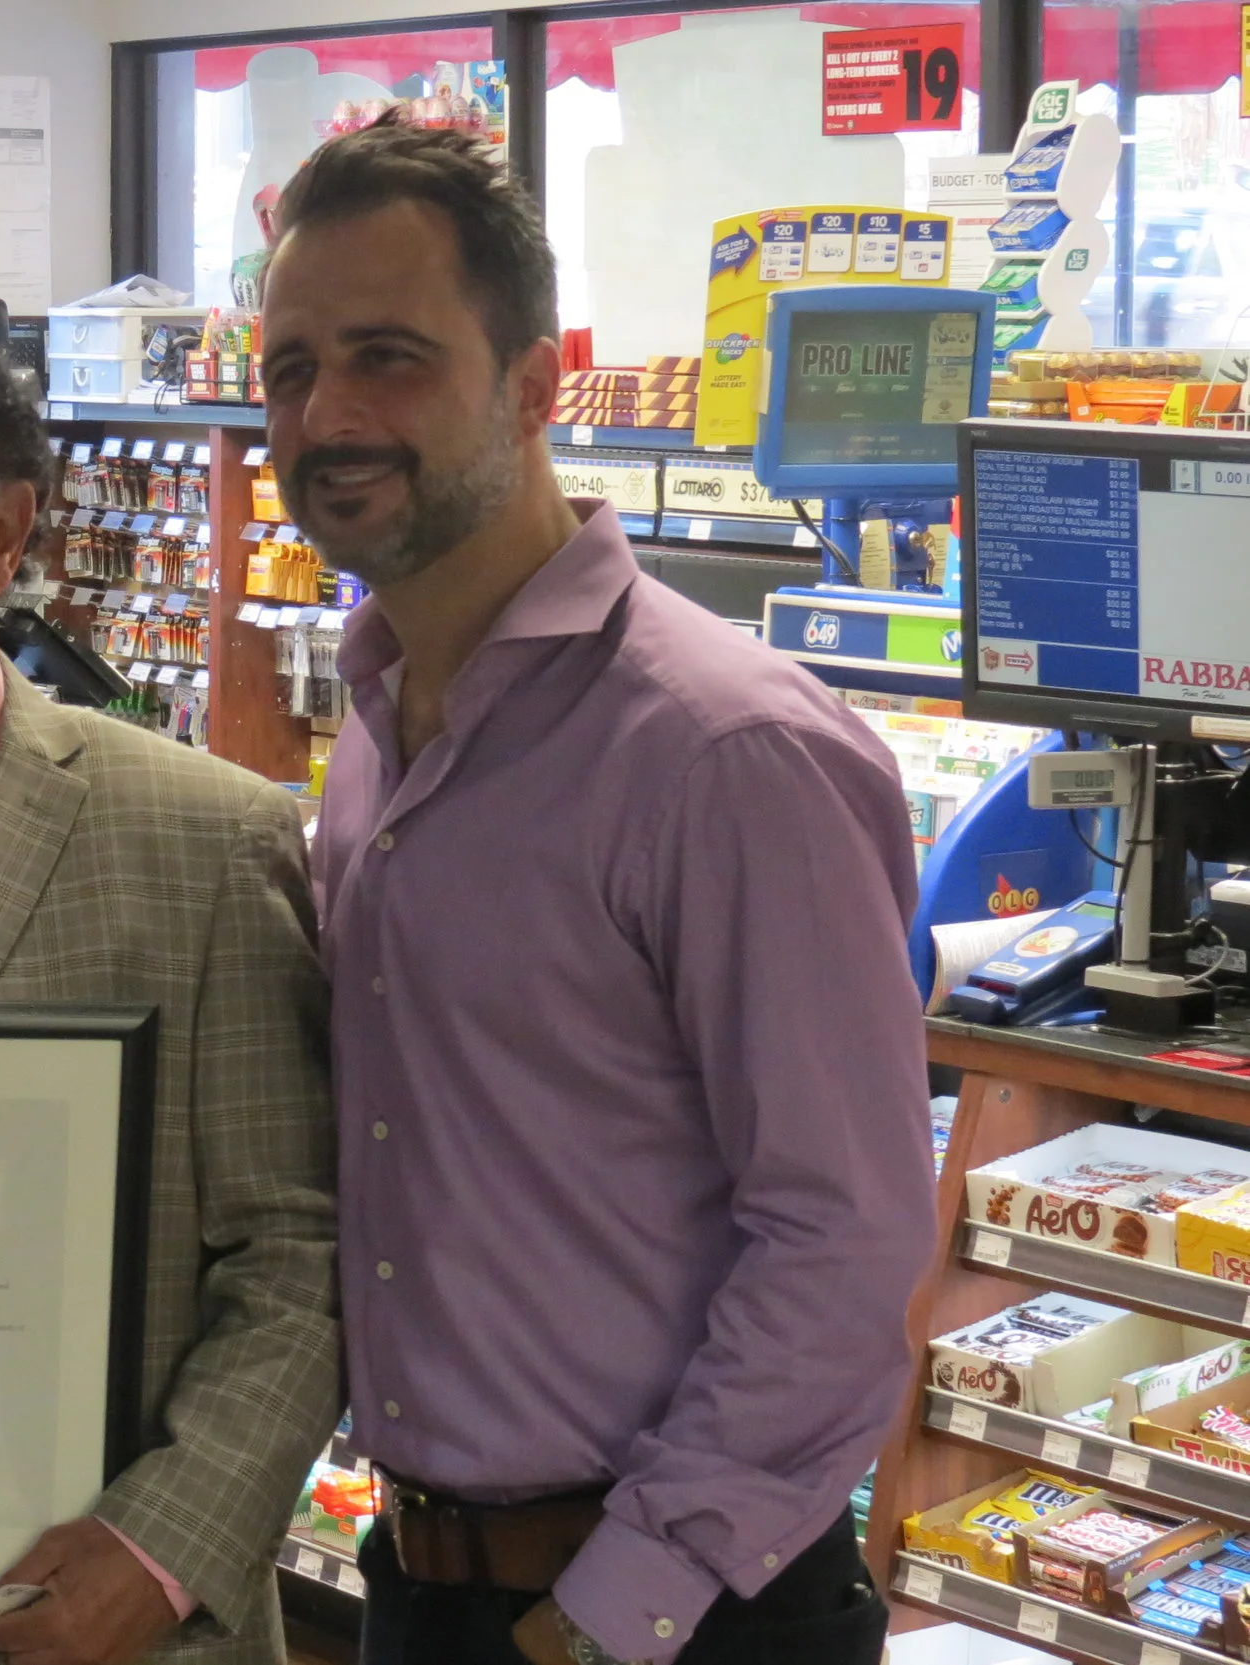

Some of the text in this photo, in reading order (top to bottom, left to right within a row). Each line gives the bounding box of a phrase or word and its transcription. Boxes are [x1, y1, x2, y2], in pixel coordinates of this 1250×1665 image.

[827, 53, 840, 64] KILL
[846, 52, 860, 63] OUT
[861, 52, 870, 63] OF
[871, 51, 892, 62] EVERY
[892, 50, 898, 61] 2
[827, 64, 901, 79] LONG-TERM SMOKERS.
[903, 47, 959, 121] 19
[1044, 92, 1065, 108] tic
[836, 104, 857, 116] YEARS
[858, 103, 867, 115] OF
[1037, 106, 1063, 120] tac
[932, 174, 975, 187] BUDGET
[822, 215, 841, 227] $20
[870, 216, 888, 227] $10
[774, 224, 793, 236] $20
[918, 223, 931, 234] $5
[705, 338, 760, 349] QUICKPICK
[802, 344, 914, 376] PRO LINE
[1215, 472, 1242, 484] 0.00
[673, 478, 724, 501] LOTTARIO
[1143, 657, 1250, 691] RABBA
[1182, 688, 1198, 697] Fine
[990, 891, 1036, 911] OLG
